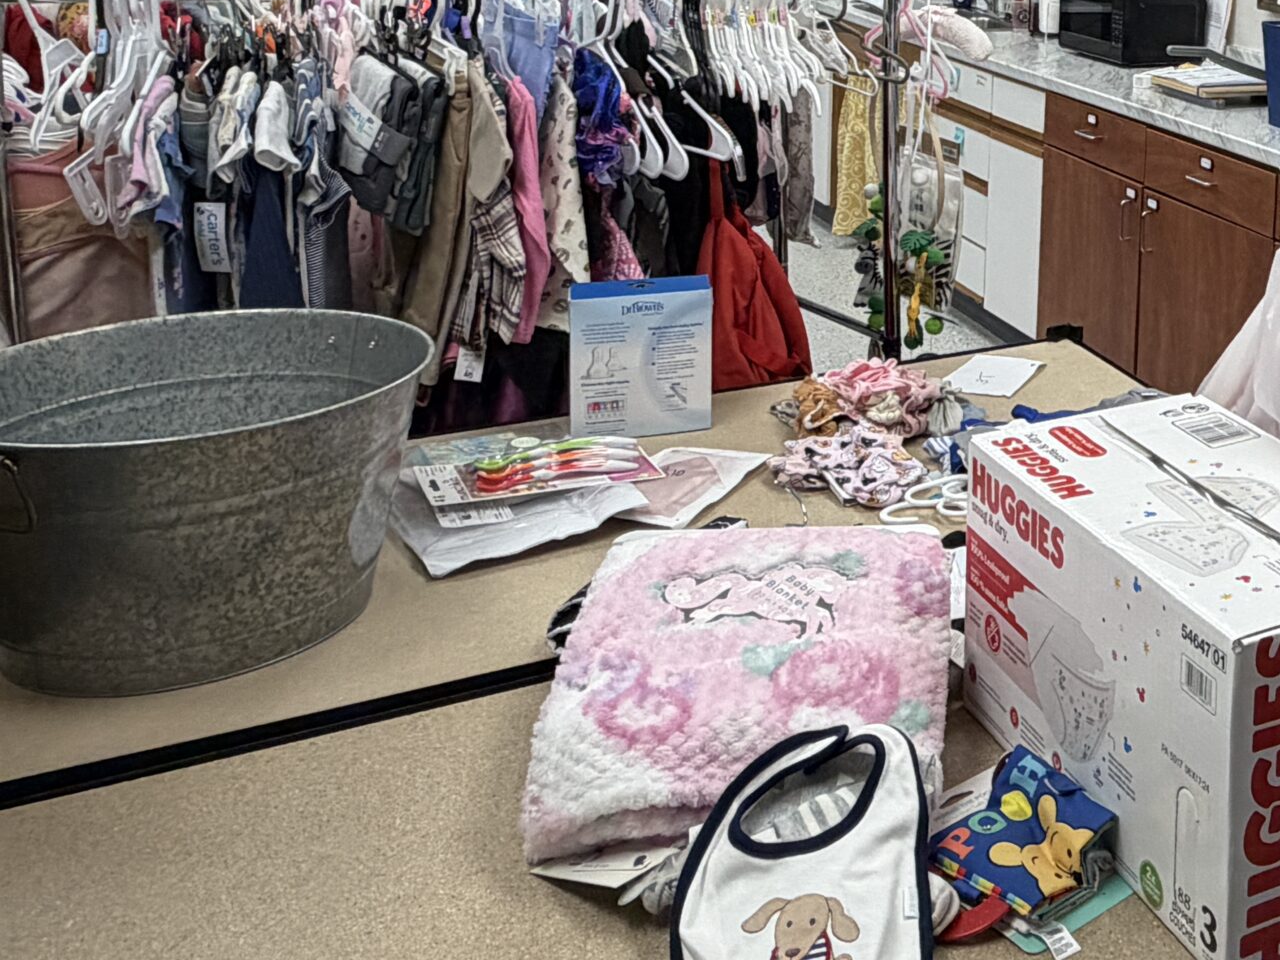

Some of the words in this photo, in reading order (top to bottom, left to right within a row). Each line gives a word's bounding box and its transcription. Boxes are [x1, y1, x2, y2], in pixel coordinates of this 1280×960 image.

[207, 213, 225, 266] carter's
[991, 437, 1094, 500] HUGGIES
[972, 456, 1065, 570] HUGGIES
[766, 580, 810, 610] Blanket
[785, 575, 815, 597] Baby
[1181, 623, 1211, 658] 54647
[1212, 648, 1225, 670] 01
[1177, 887, 1191, 911] 88
[1200, 905, 1217, 953] 3
